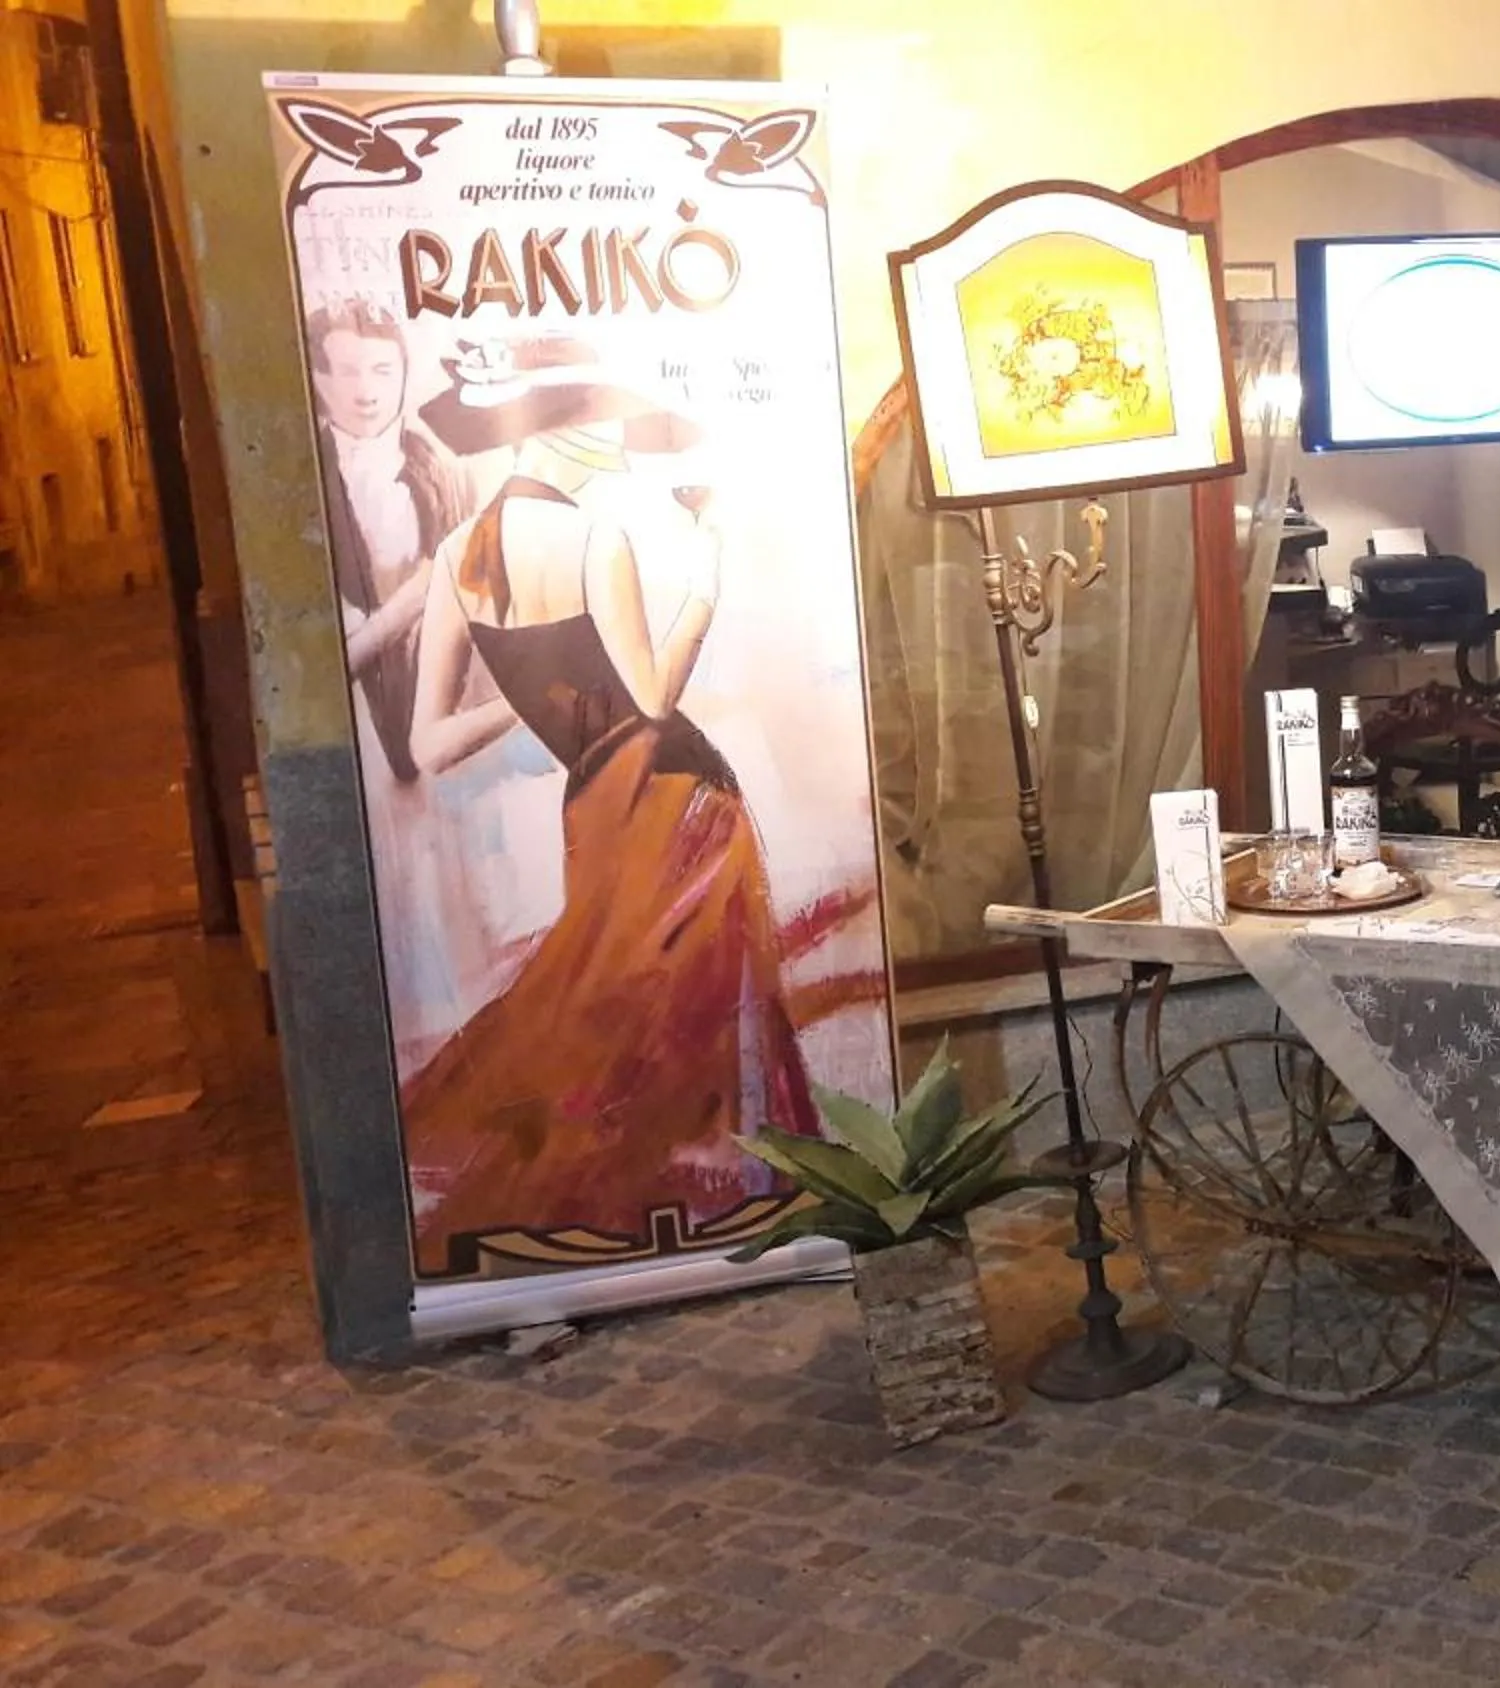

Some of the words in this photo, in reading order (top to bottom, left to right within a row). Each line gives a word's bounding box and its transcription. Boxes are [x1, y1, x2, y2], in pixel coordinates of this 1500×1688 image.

[504, 116, 543, 141] dal
[550, 115, 600, 142] 1895
[515, 147, 597, 174] liquore
[459, 177, 563, 206] aperitivo
[569, 183, 582, 201] e
[588, 177, 655, 201] tonico
